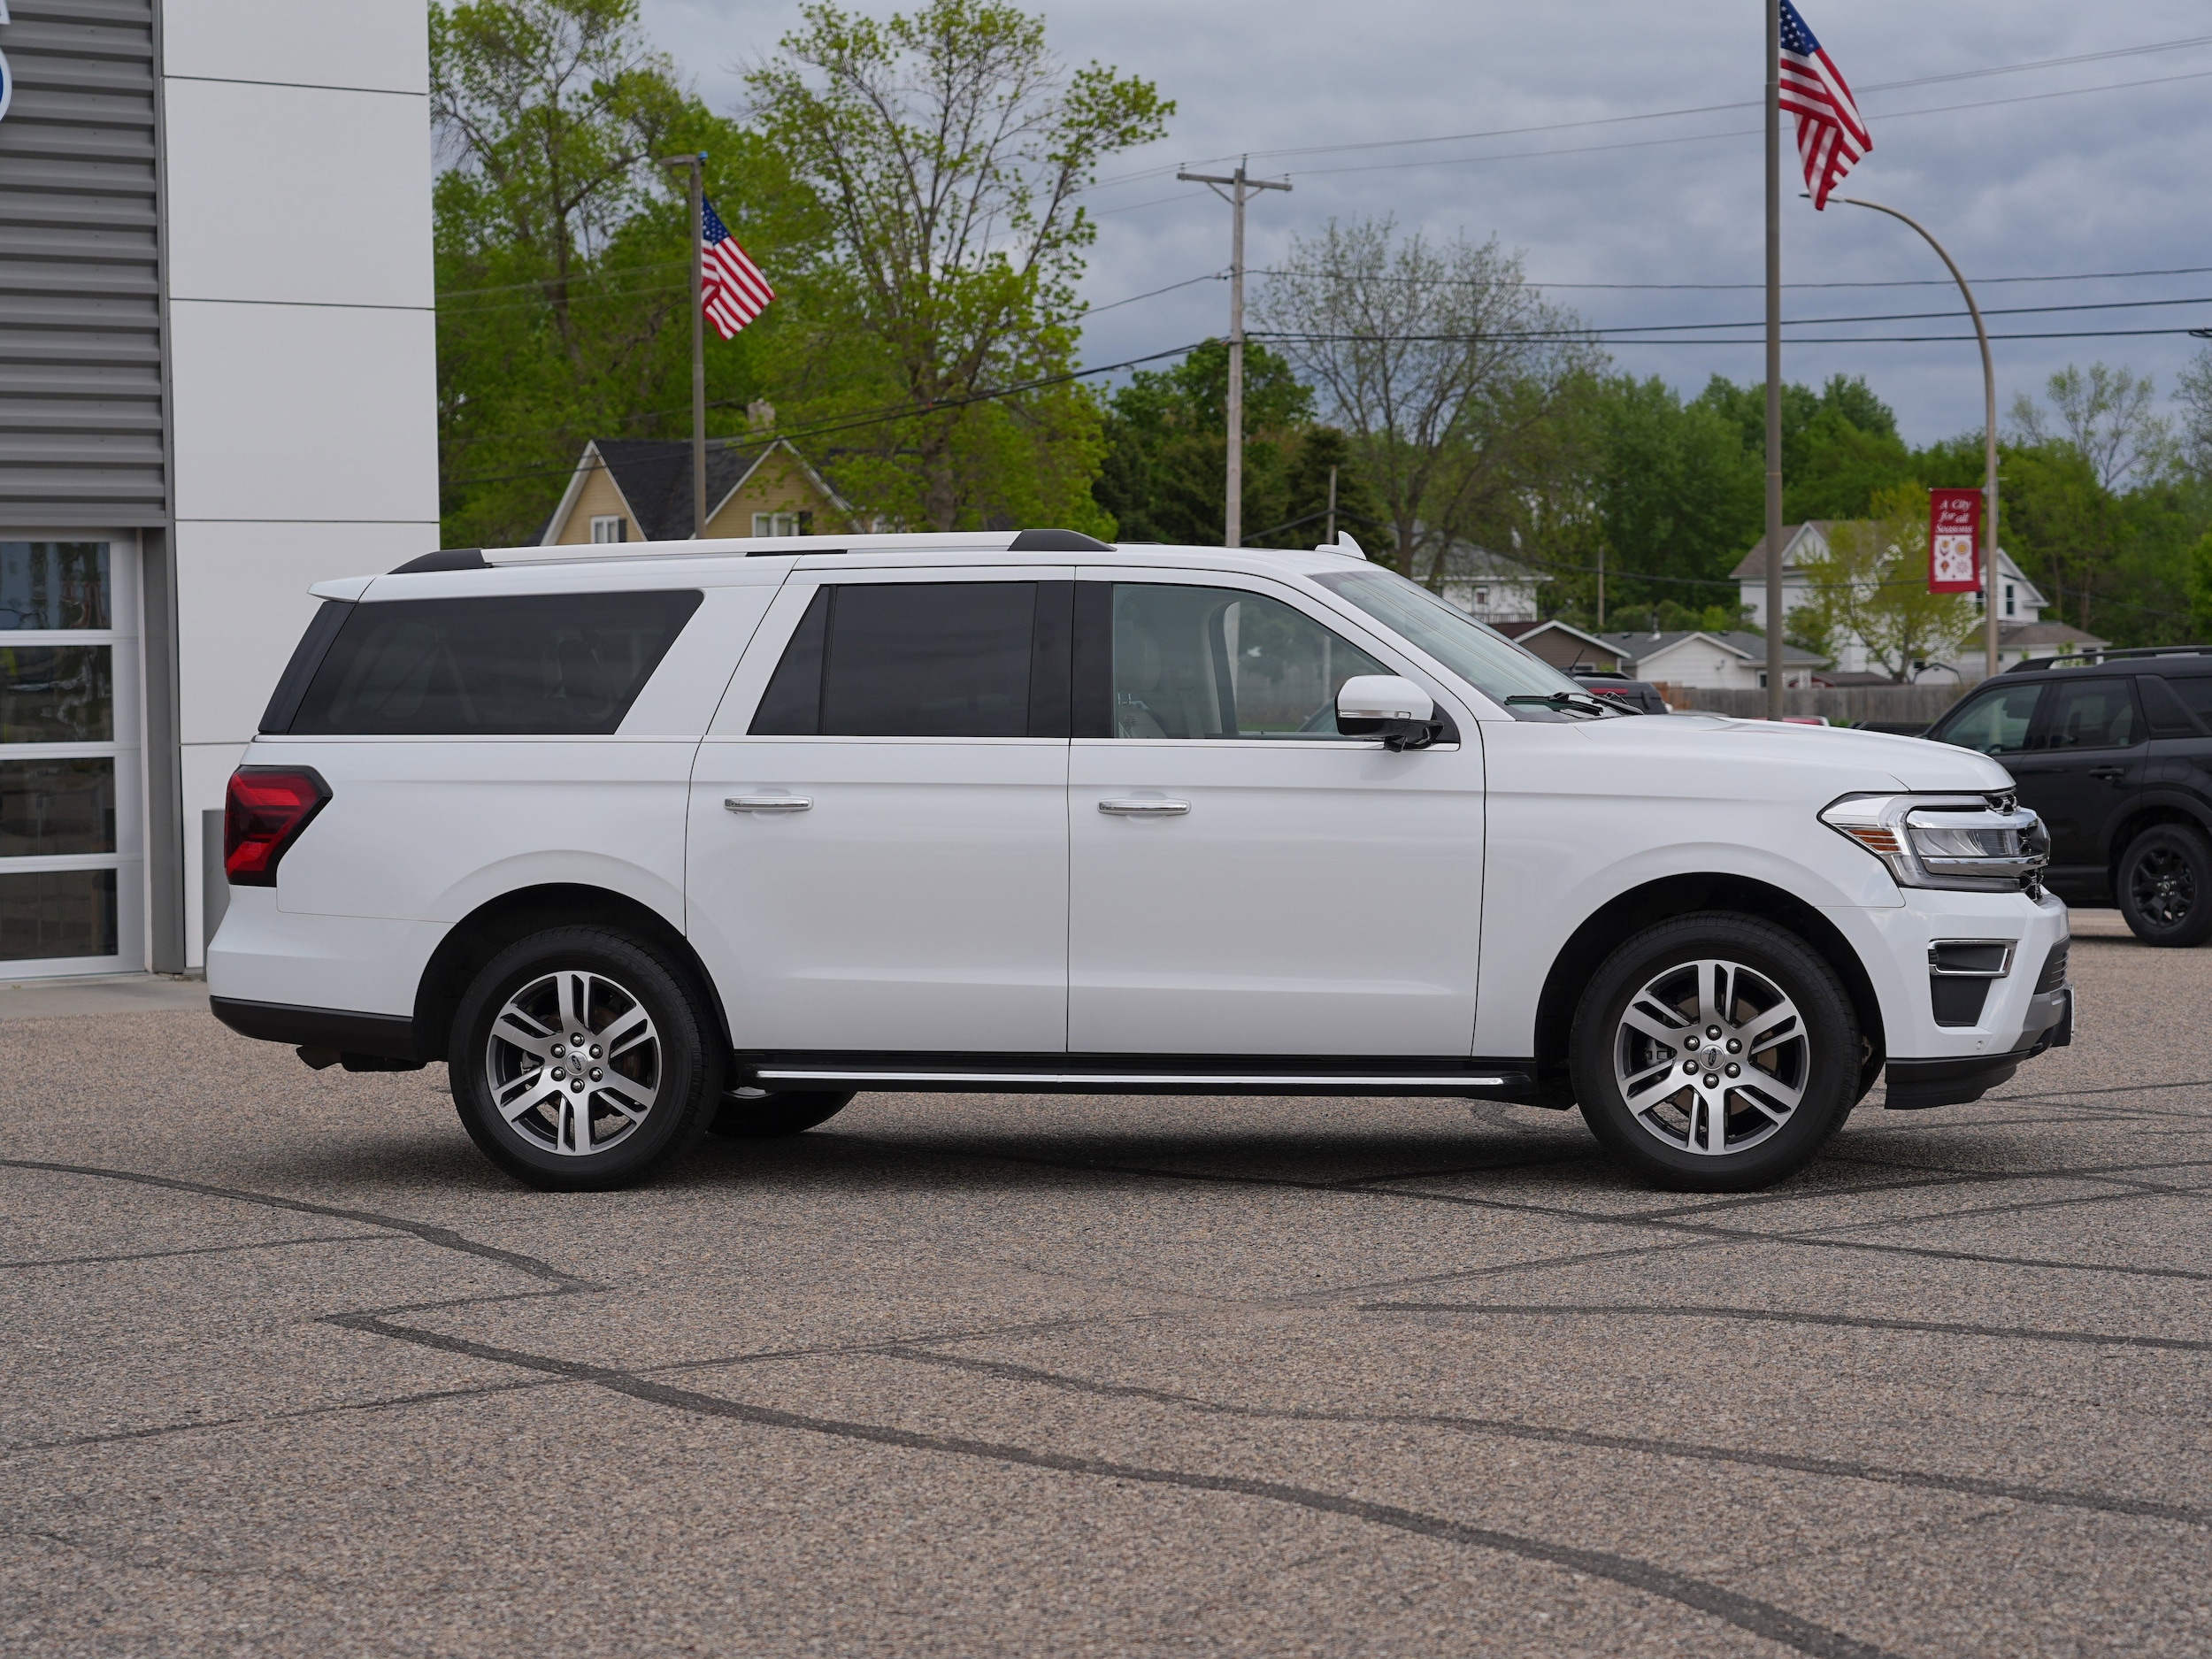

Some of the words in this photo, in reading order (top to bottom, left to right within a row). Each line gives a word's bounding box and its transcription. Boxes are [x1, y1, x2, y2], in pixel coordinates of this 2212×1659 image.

[1939, 499, 1948, 509] A
[1951, 499, 1972, 512] City
[1939, 511, 1956, 524] for
[1955, 513, 1970, 523] all
[1935, 524, 1973, 534] Seasons
